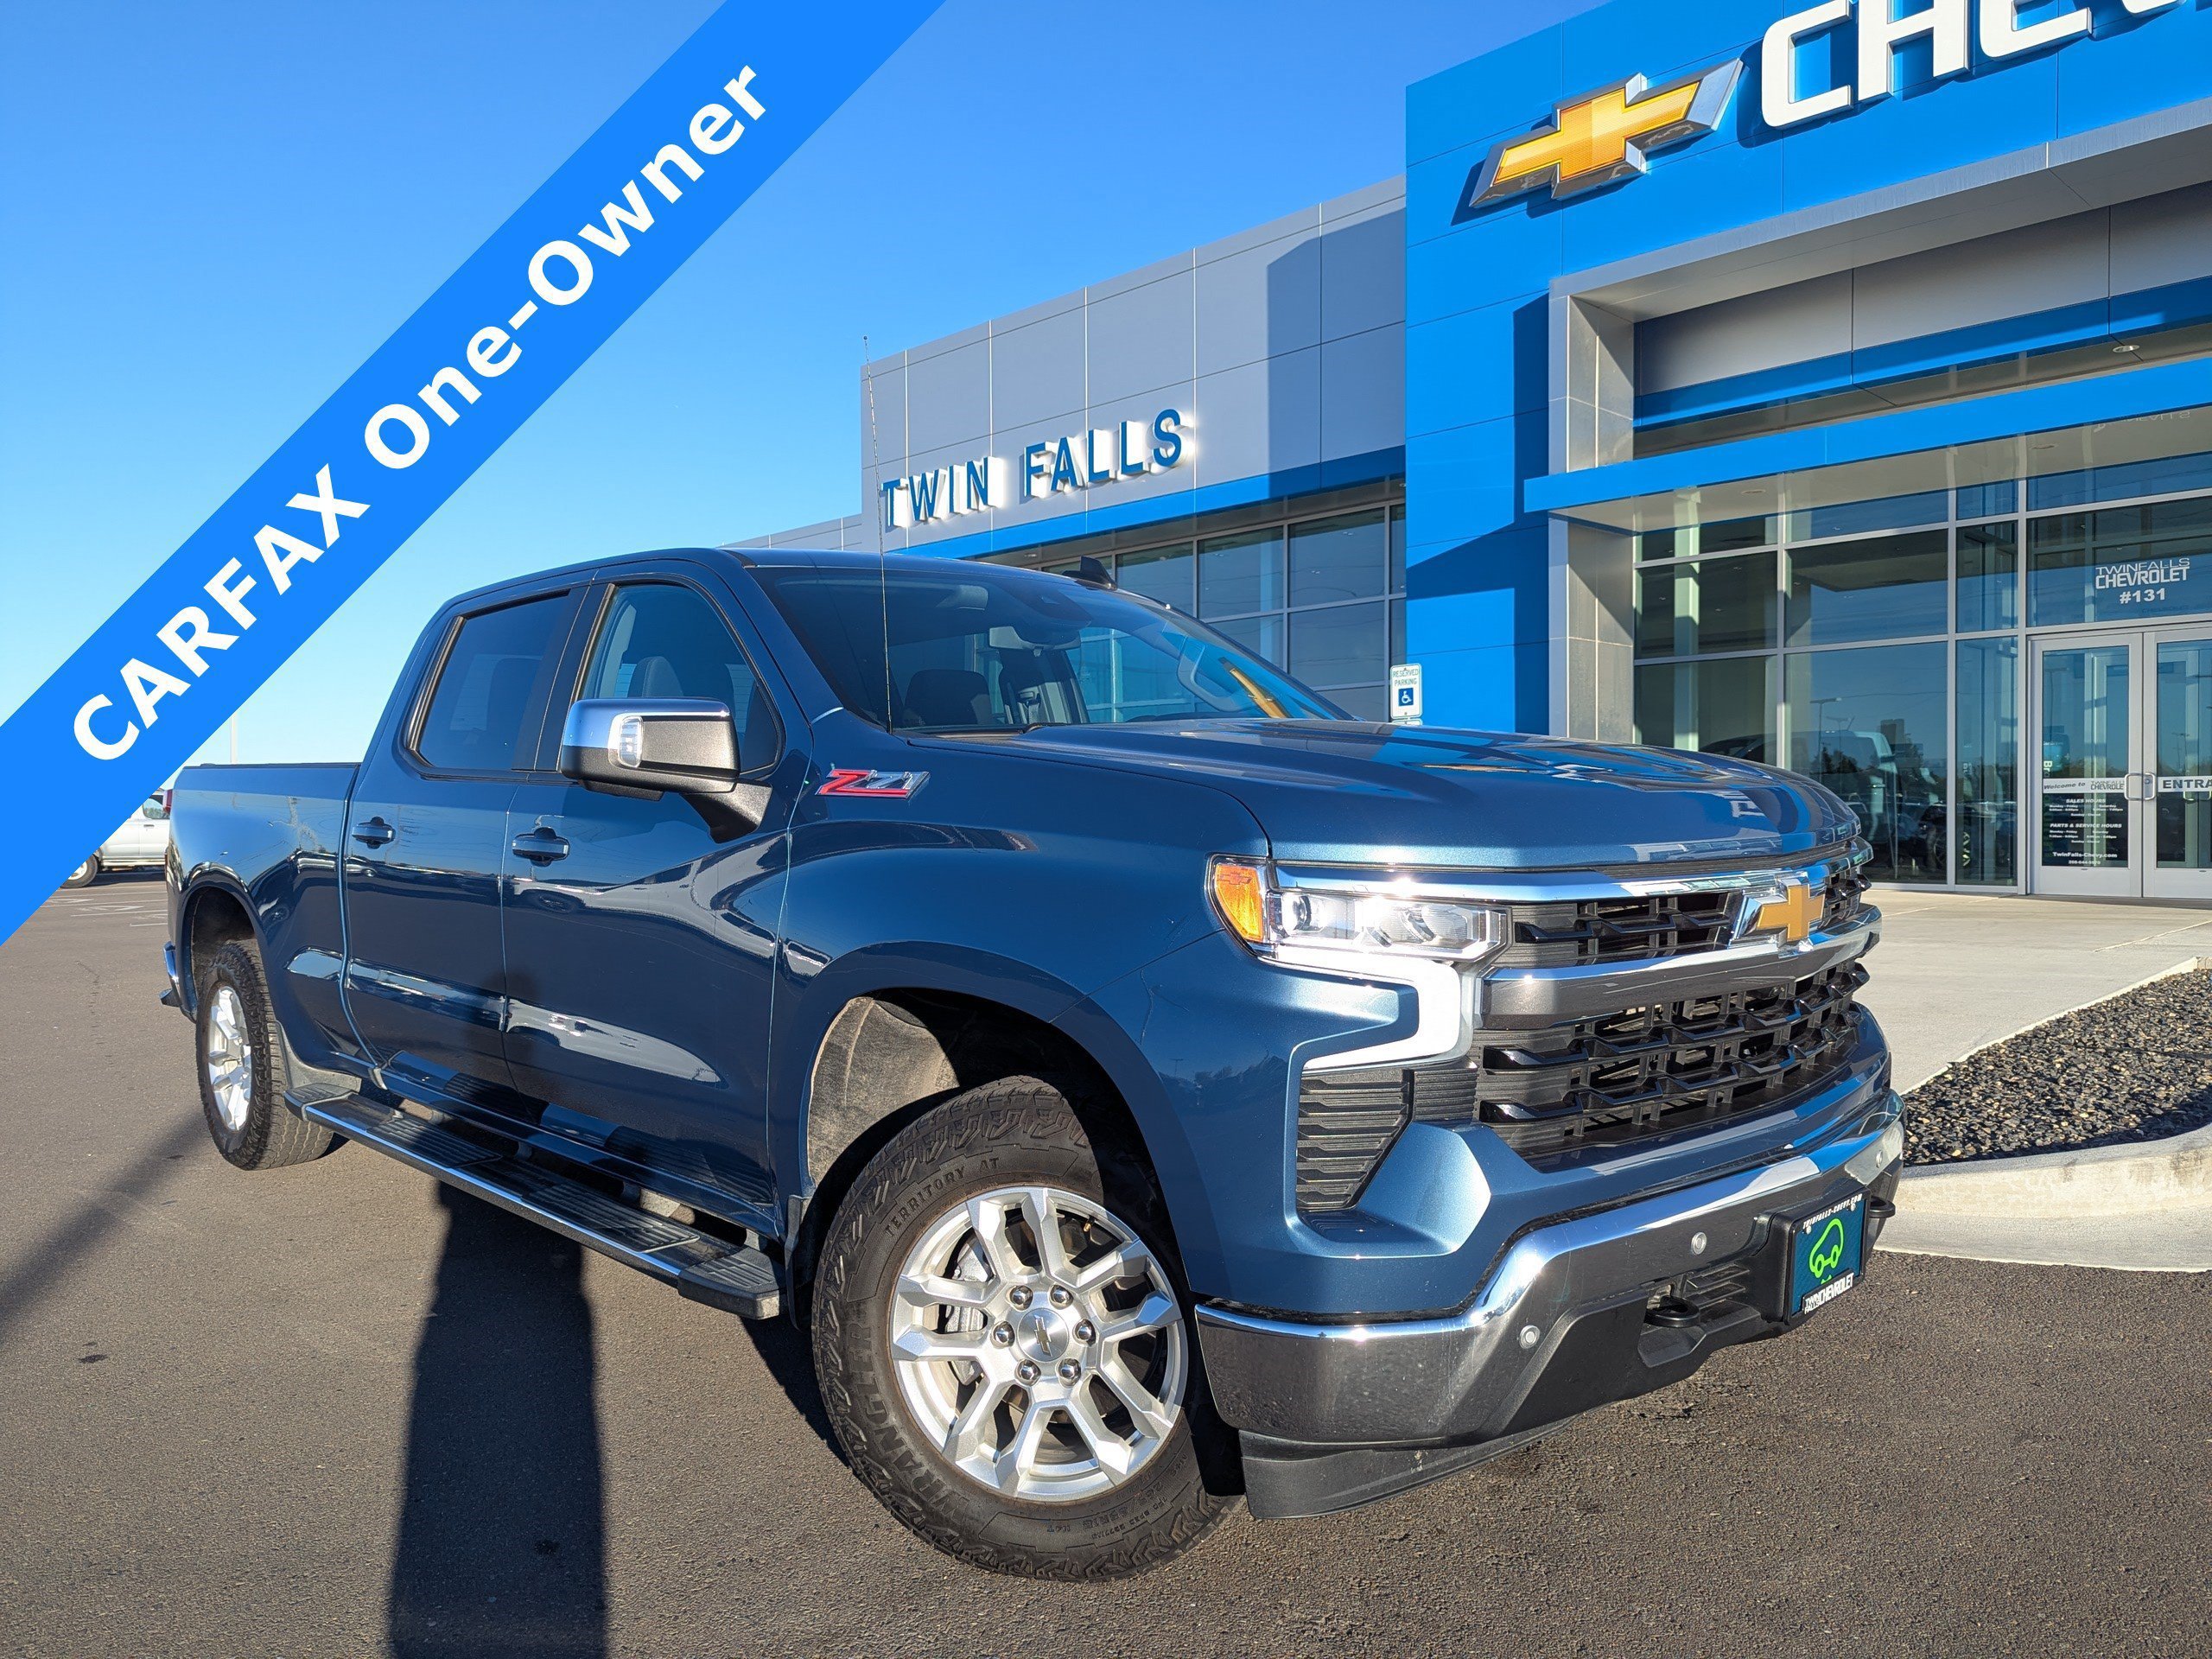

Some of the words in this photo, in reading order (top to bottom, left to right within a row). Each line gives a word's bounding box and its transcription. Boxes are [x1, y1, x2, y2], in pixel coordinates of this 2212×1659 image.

[1762, 0, 2183, 129] CHE
[880, 456, 999, 528] TWIN
[1024, 409, 1186, 499] FALLS
[2095, 566, 2190, 589] CHEVROLET
[2119, 588, 2165, 605] #131
[1392, 669, 1419, 678] RESERVED
[885, 1166, 965, 1237] TERRITORY
[980, 1157, 1000, 1170] AT
[1818, 1272, 1854, 1306] CHEVROLET
[848, 1323, 969, 1524] WRANGLER
